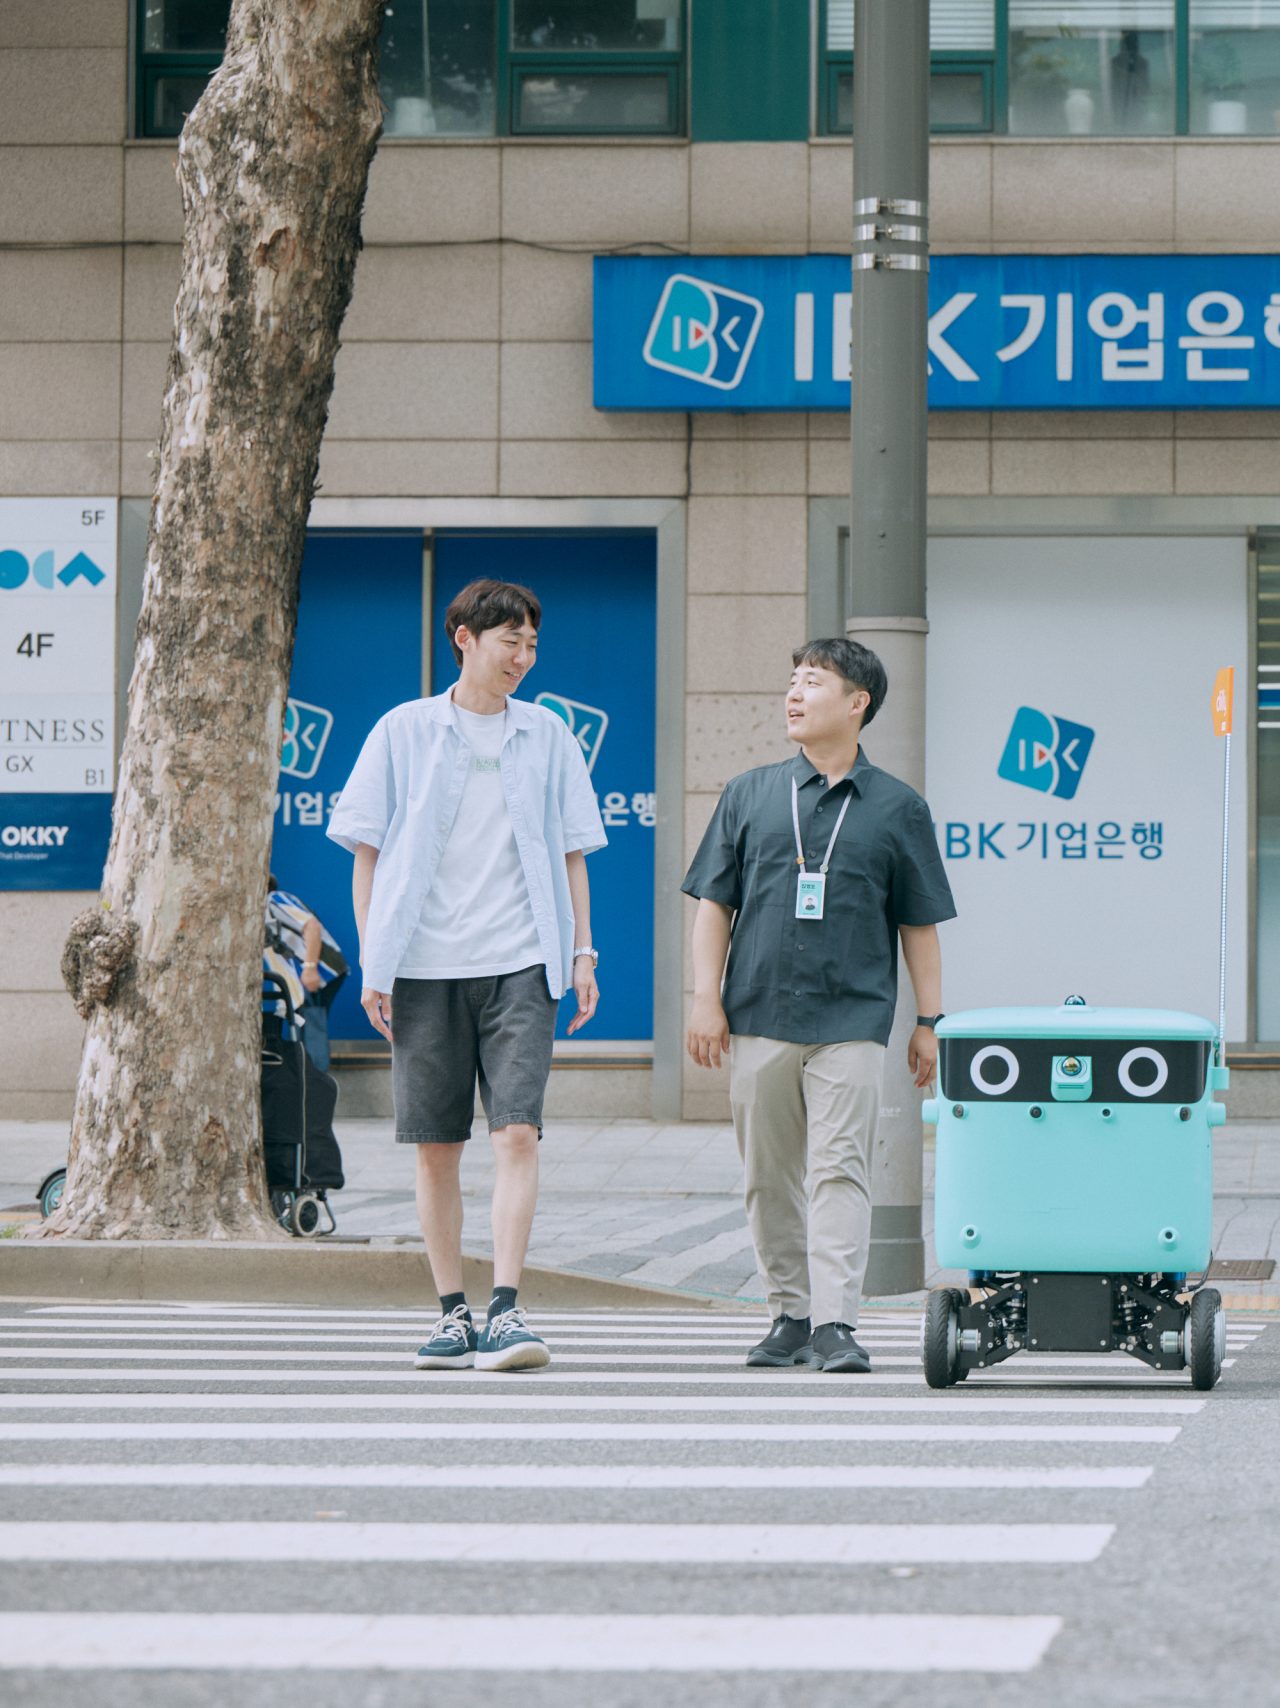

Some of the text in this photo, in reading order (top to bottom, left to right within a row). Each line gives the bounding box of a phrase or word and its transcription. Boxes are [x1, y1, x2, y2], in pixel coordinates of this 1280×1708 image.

[81, 510, 106, 526] 5F
[16, 633, 54, 657] 4F
[0, 719, 105, 742] TNESS
[6, 755, 34, 773] GX
[85, 768, 105, 786] B1
[593, 791, 657, 827] 은행
[1, 826, 69, 847] OKKY
[931, 821, 1164, 860] BK기업은행
[14, 851, 49, 861] Developer
